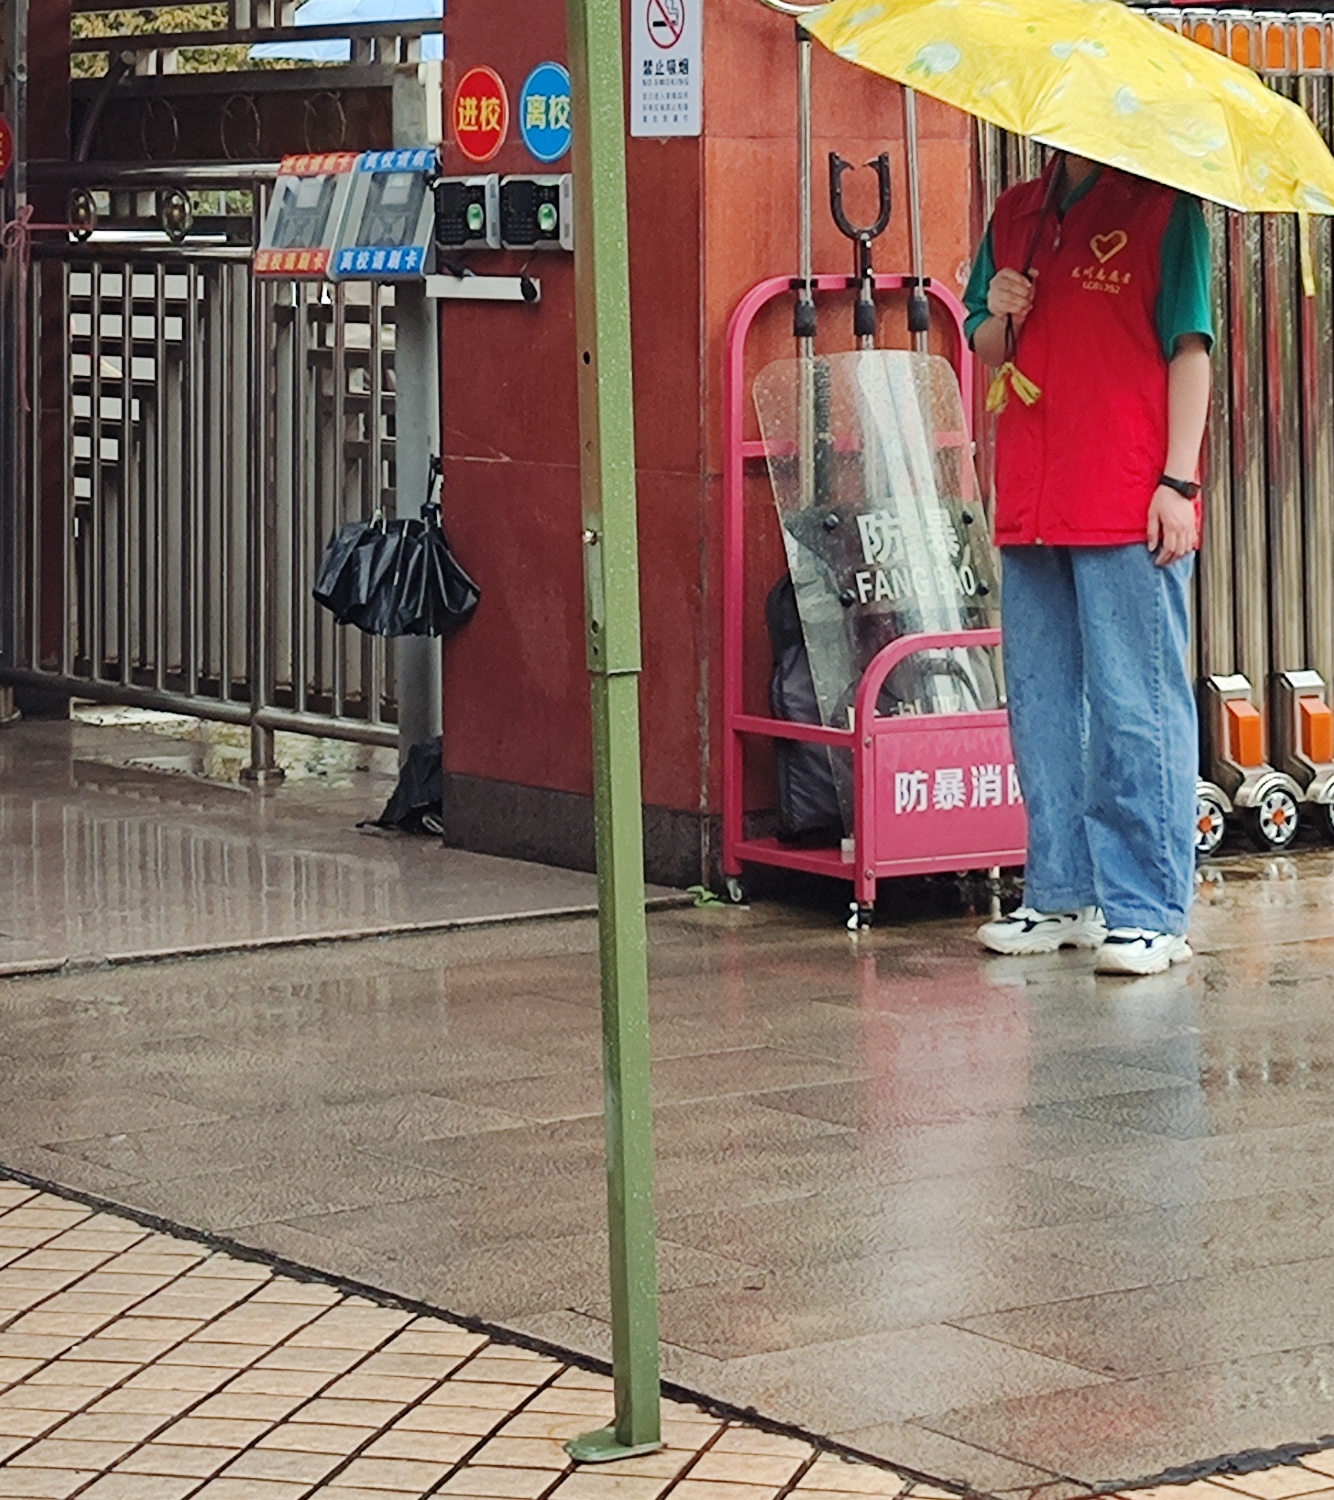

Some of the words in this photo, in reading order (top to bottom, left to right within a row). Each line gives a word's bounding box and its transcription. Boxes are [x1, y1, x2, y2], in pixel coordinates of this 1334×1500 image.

[643, 58, 688, 76] 禁止吸烟
[457, 96, 501, 132] 进校
[525, 94, 572, 131] 离校
[364, 149, 435, 169] 离校请刷
[339, 248, 418, 272] 离校请刷卡
